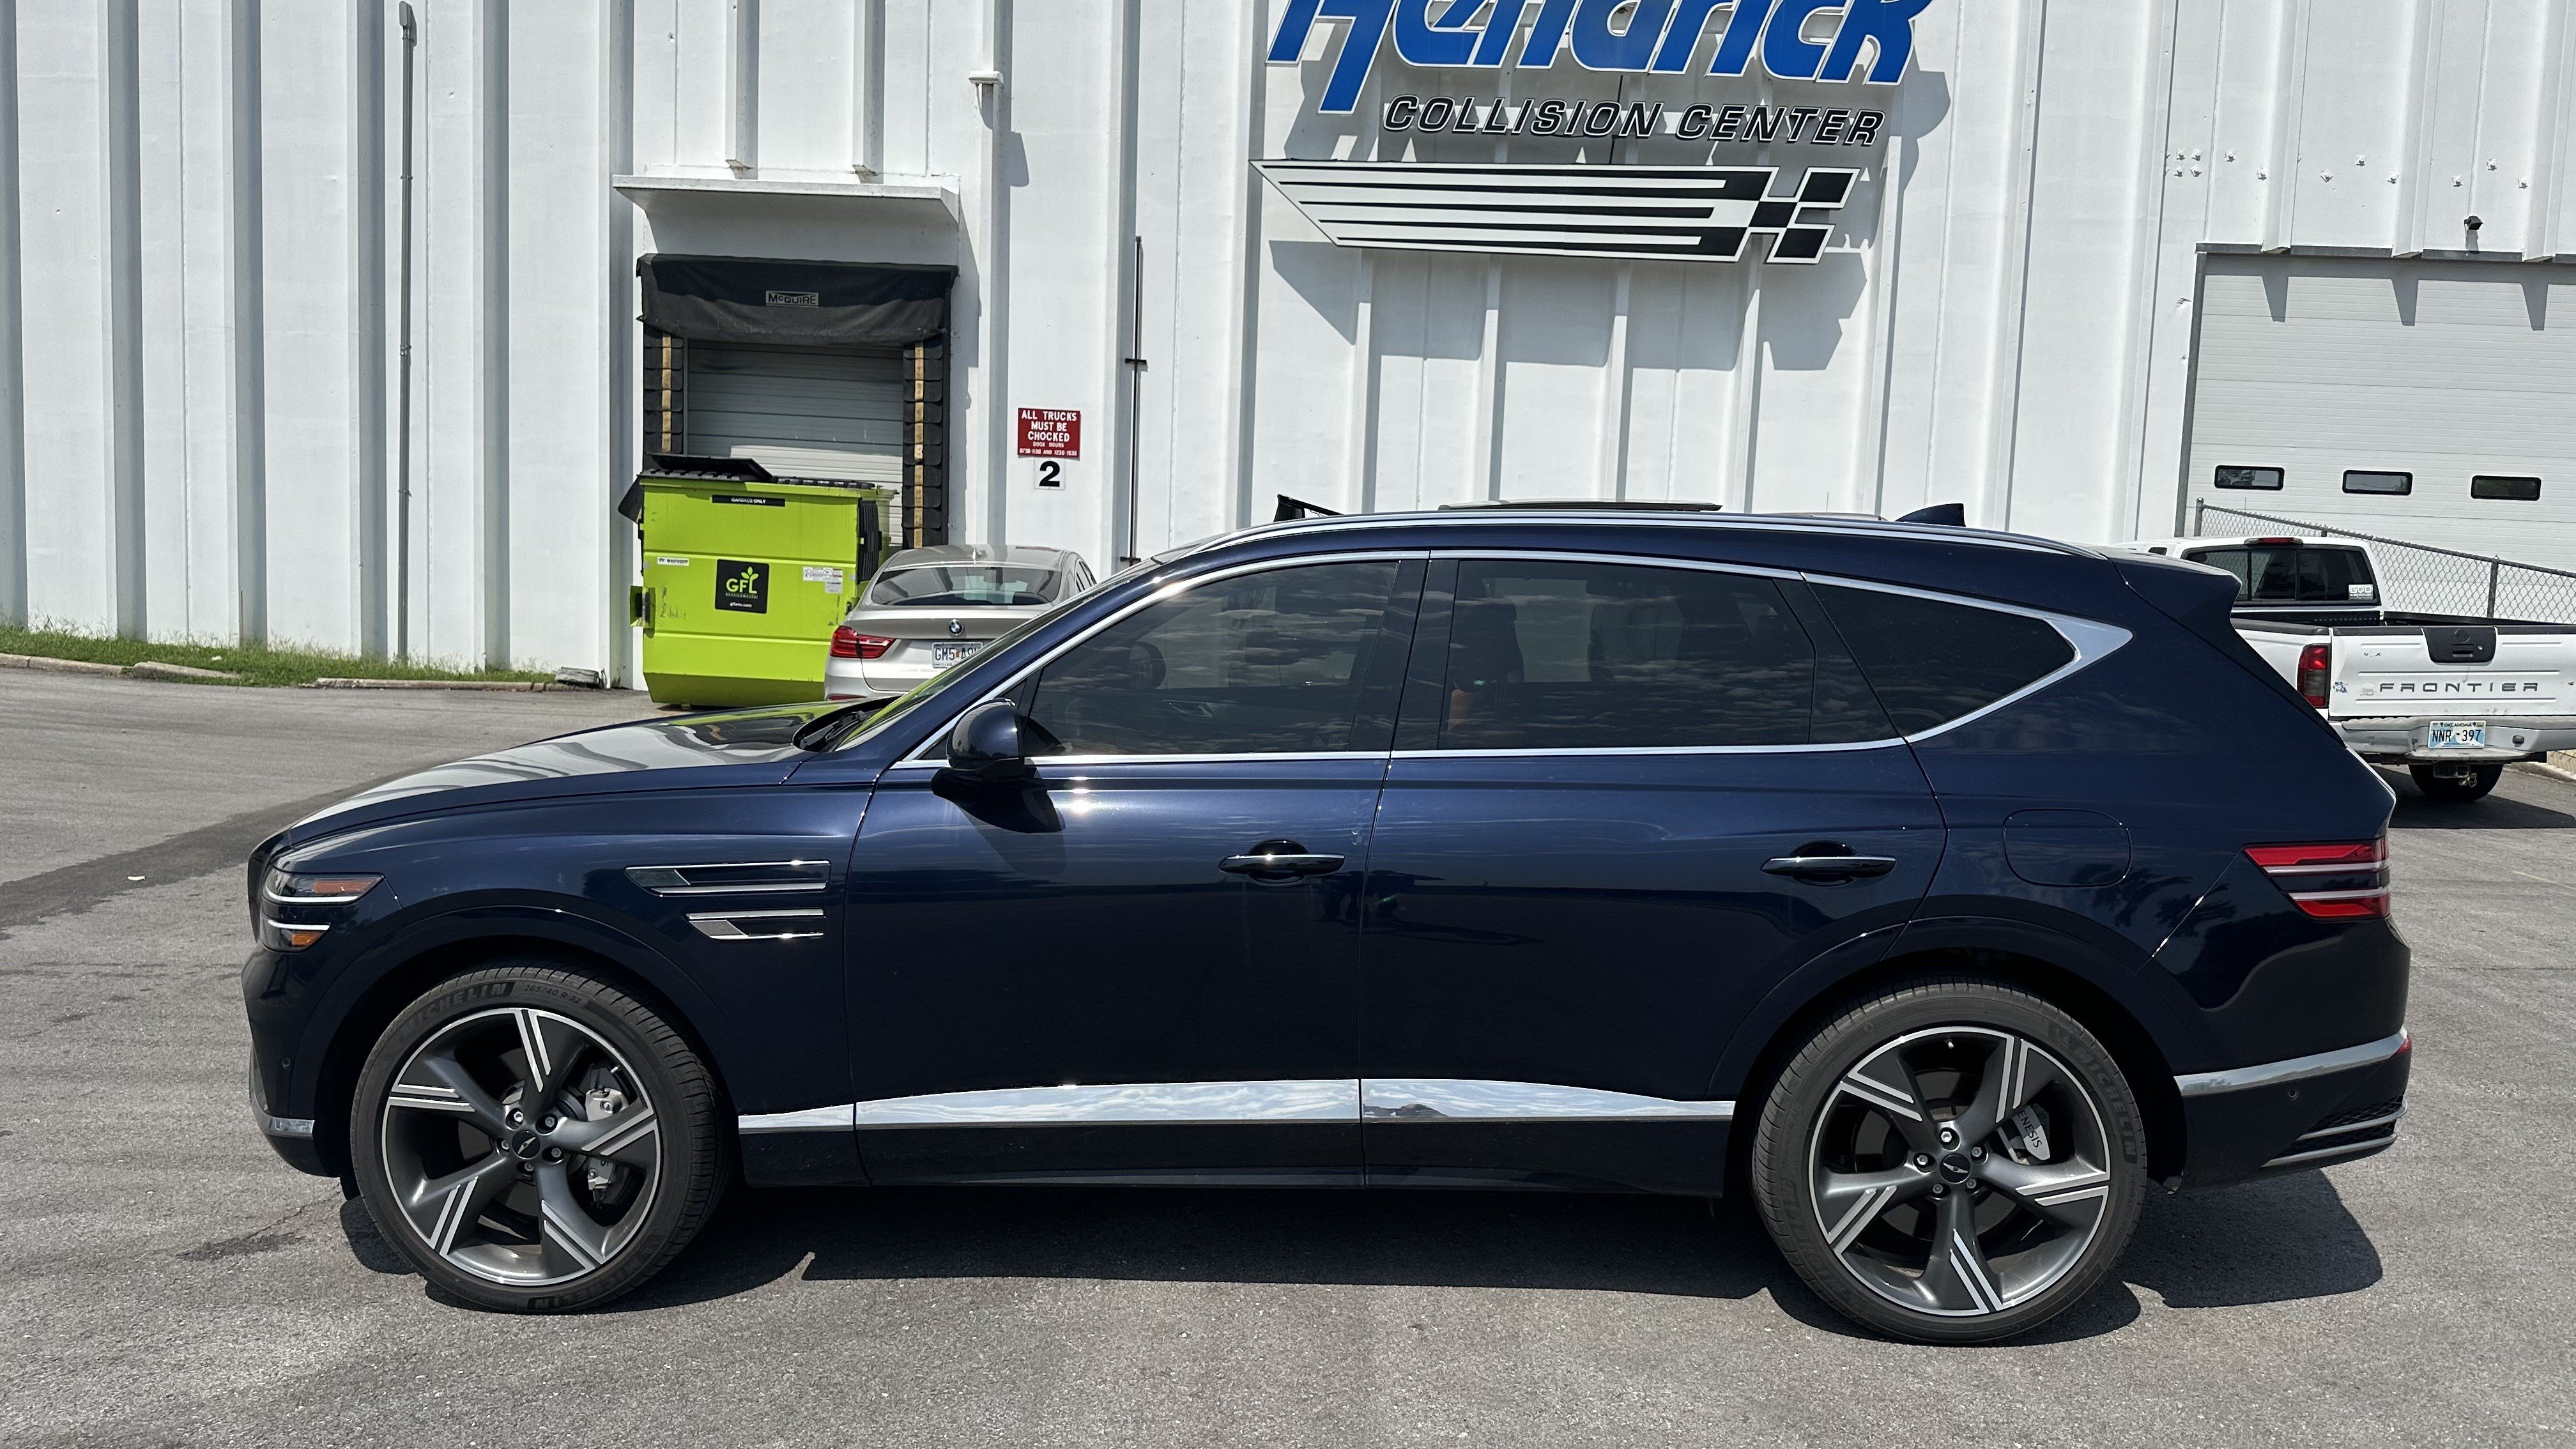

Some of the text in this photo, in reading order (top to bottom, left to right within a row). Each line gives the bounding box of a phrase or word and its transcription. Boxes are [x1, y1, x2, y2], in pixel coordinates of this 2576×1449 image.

[1383, 95, 1885, 146] COLLISION CENTER
[1022, 410, 1077, 421] ALL TRUCKS
[1031, 421, 1068, 431] MUST BE
[1027, 431, 1070, 442] CHOCKED
[1039, 461, 1060, 487] 2
[726, 573, 758, 594] GFL
[935, 647, 977, 661] GM5 A9
[2379, 682, 2538, 693] FRONTIER
[523, 985, 559, 996] 265/40
[560, 992, 568, 1000] R
[568, 995, 582, 1004] 22
[402, 983, 509, 1037] MICHELIN
[2074, 1046, 2138, 1156] MICHELIN
[2018, 1110, 2043, 1148] ENESIS
